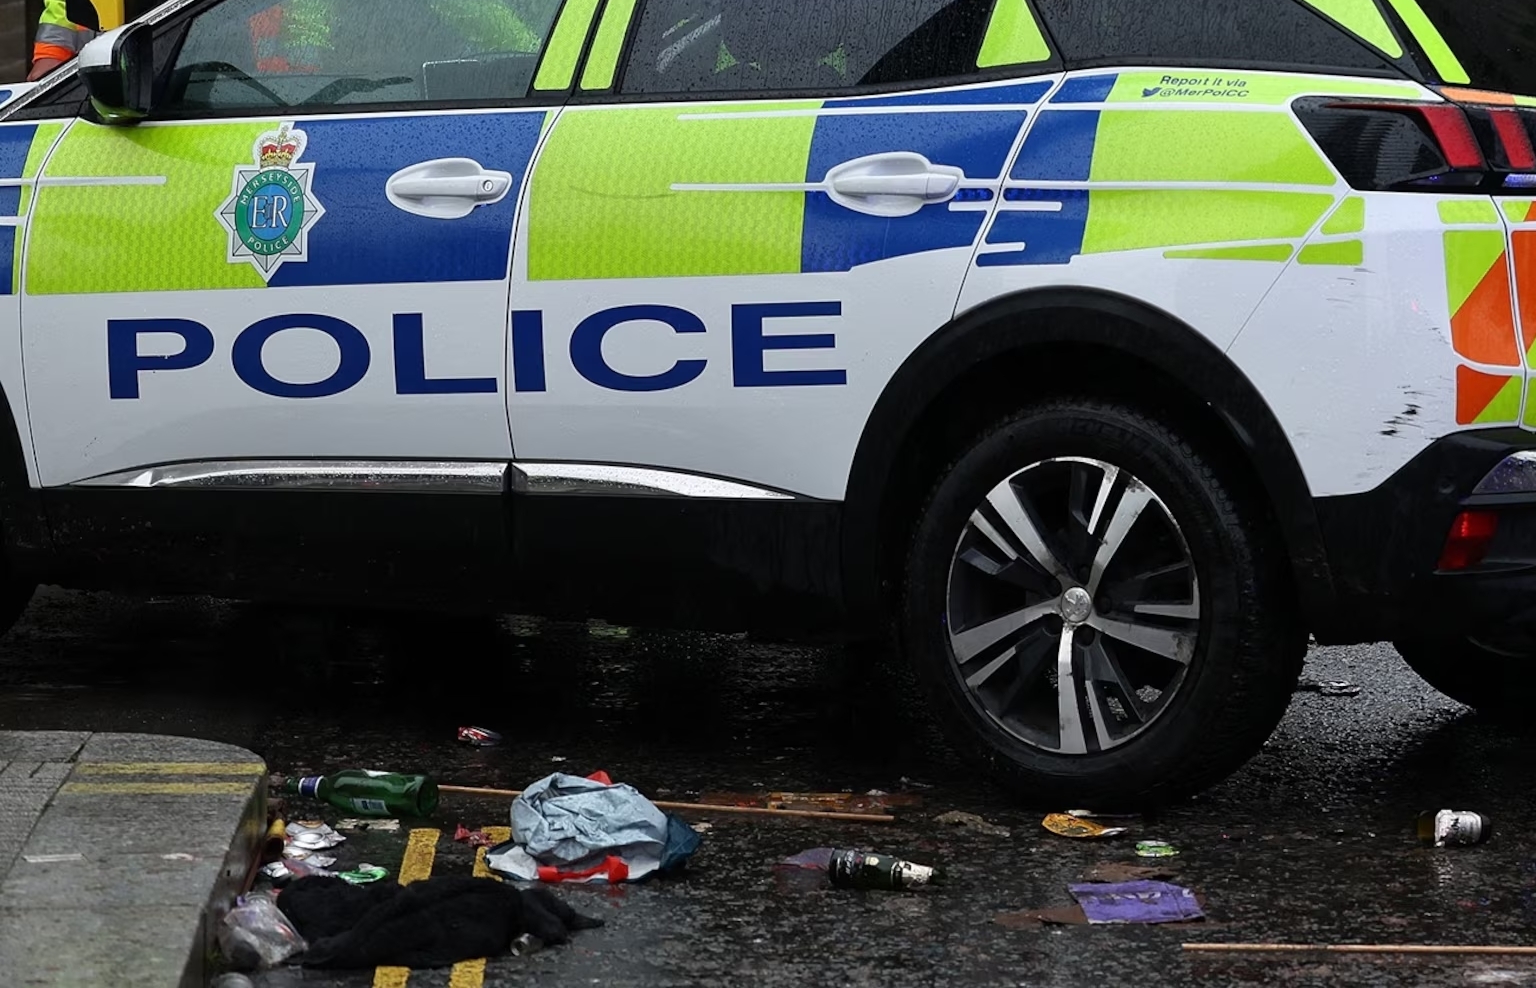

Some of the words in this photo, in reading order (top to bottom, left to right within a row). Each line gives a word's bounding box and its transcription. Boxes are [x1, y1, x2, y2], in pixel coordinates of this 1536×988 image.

[1159, 75, 1210, 87] Report
[1212, 77, 1223, 86] it
[1226, 78, 1247, 87] via
[240, 171, 301, 206] MERSEYSIDE
[247, 236, 290, 253] POLICE
[106, 300, 849, 401] POLICE
